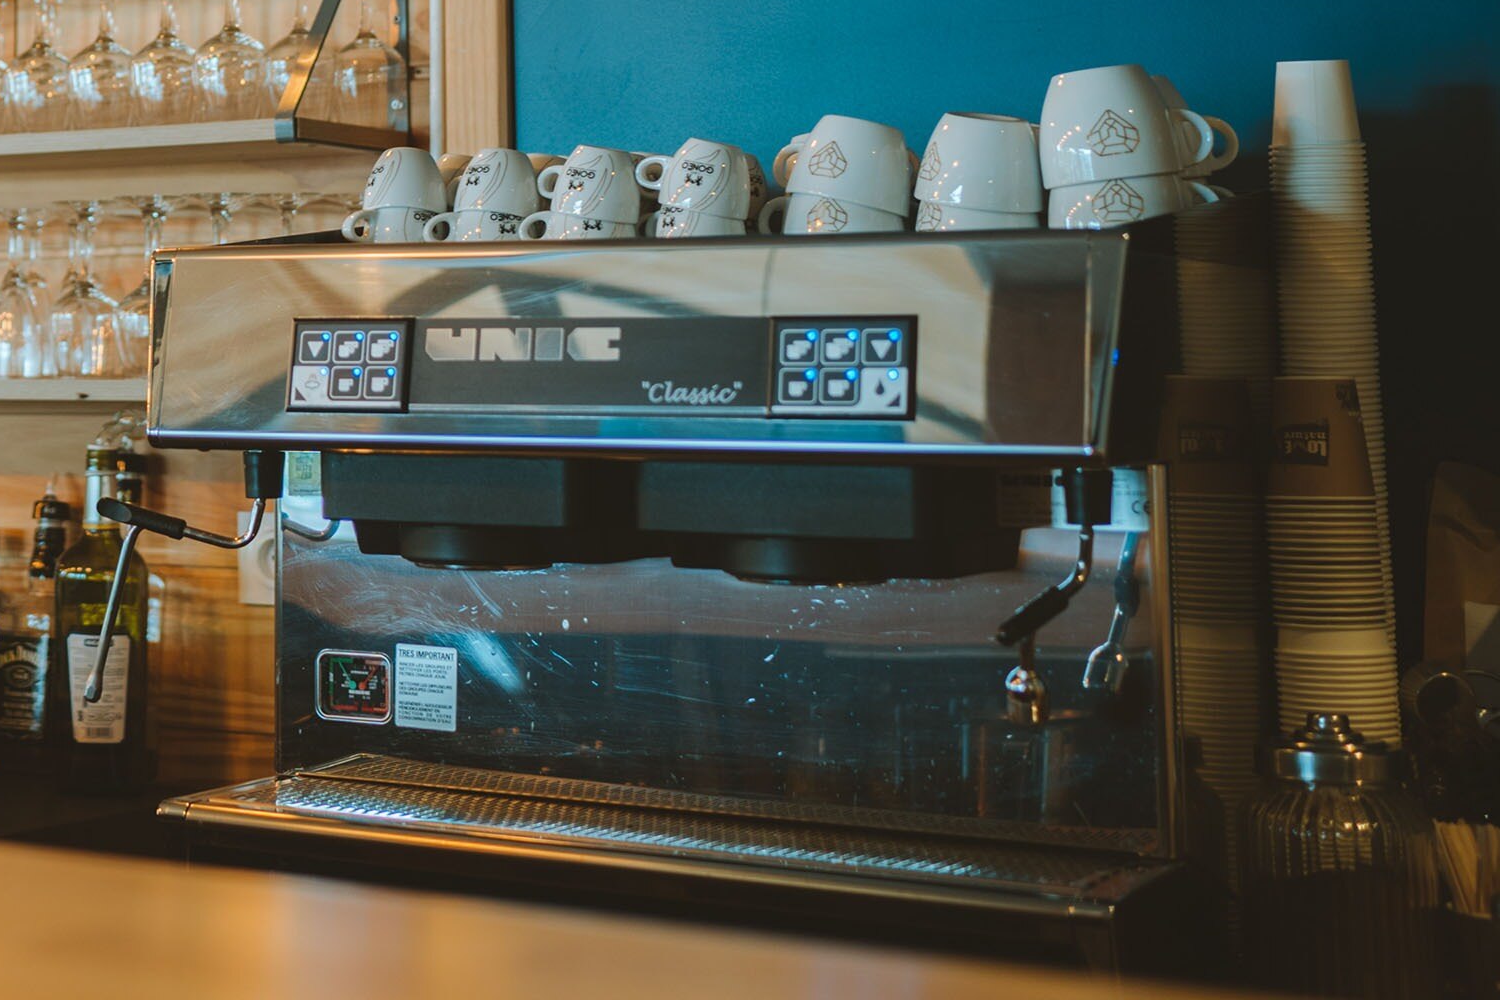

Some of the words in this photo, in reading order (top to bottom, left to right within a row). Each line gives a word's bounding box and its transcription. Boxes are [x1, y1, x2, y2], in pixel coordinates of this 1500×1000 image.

[425, 327, 621, 361] UNIC
[399, 648, 415, 658] TRES
[416, 650, 455, 661] IMPORTANT
